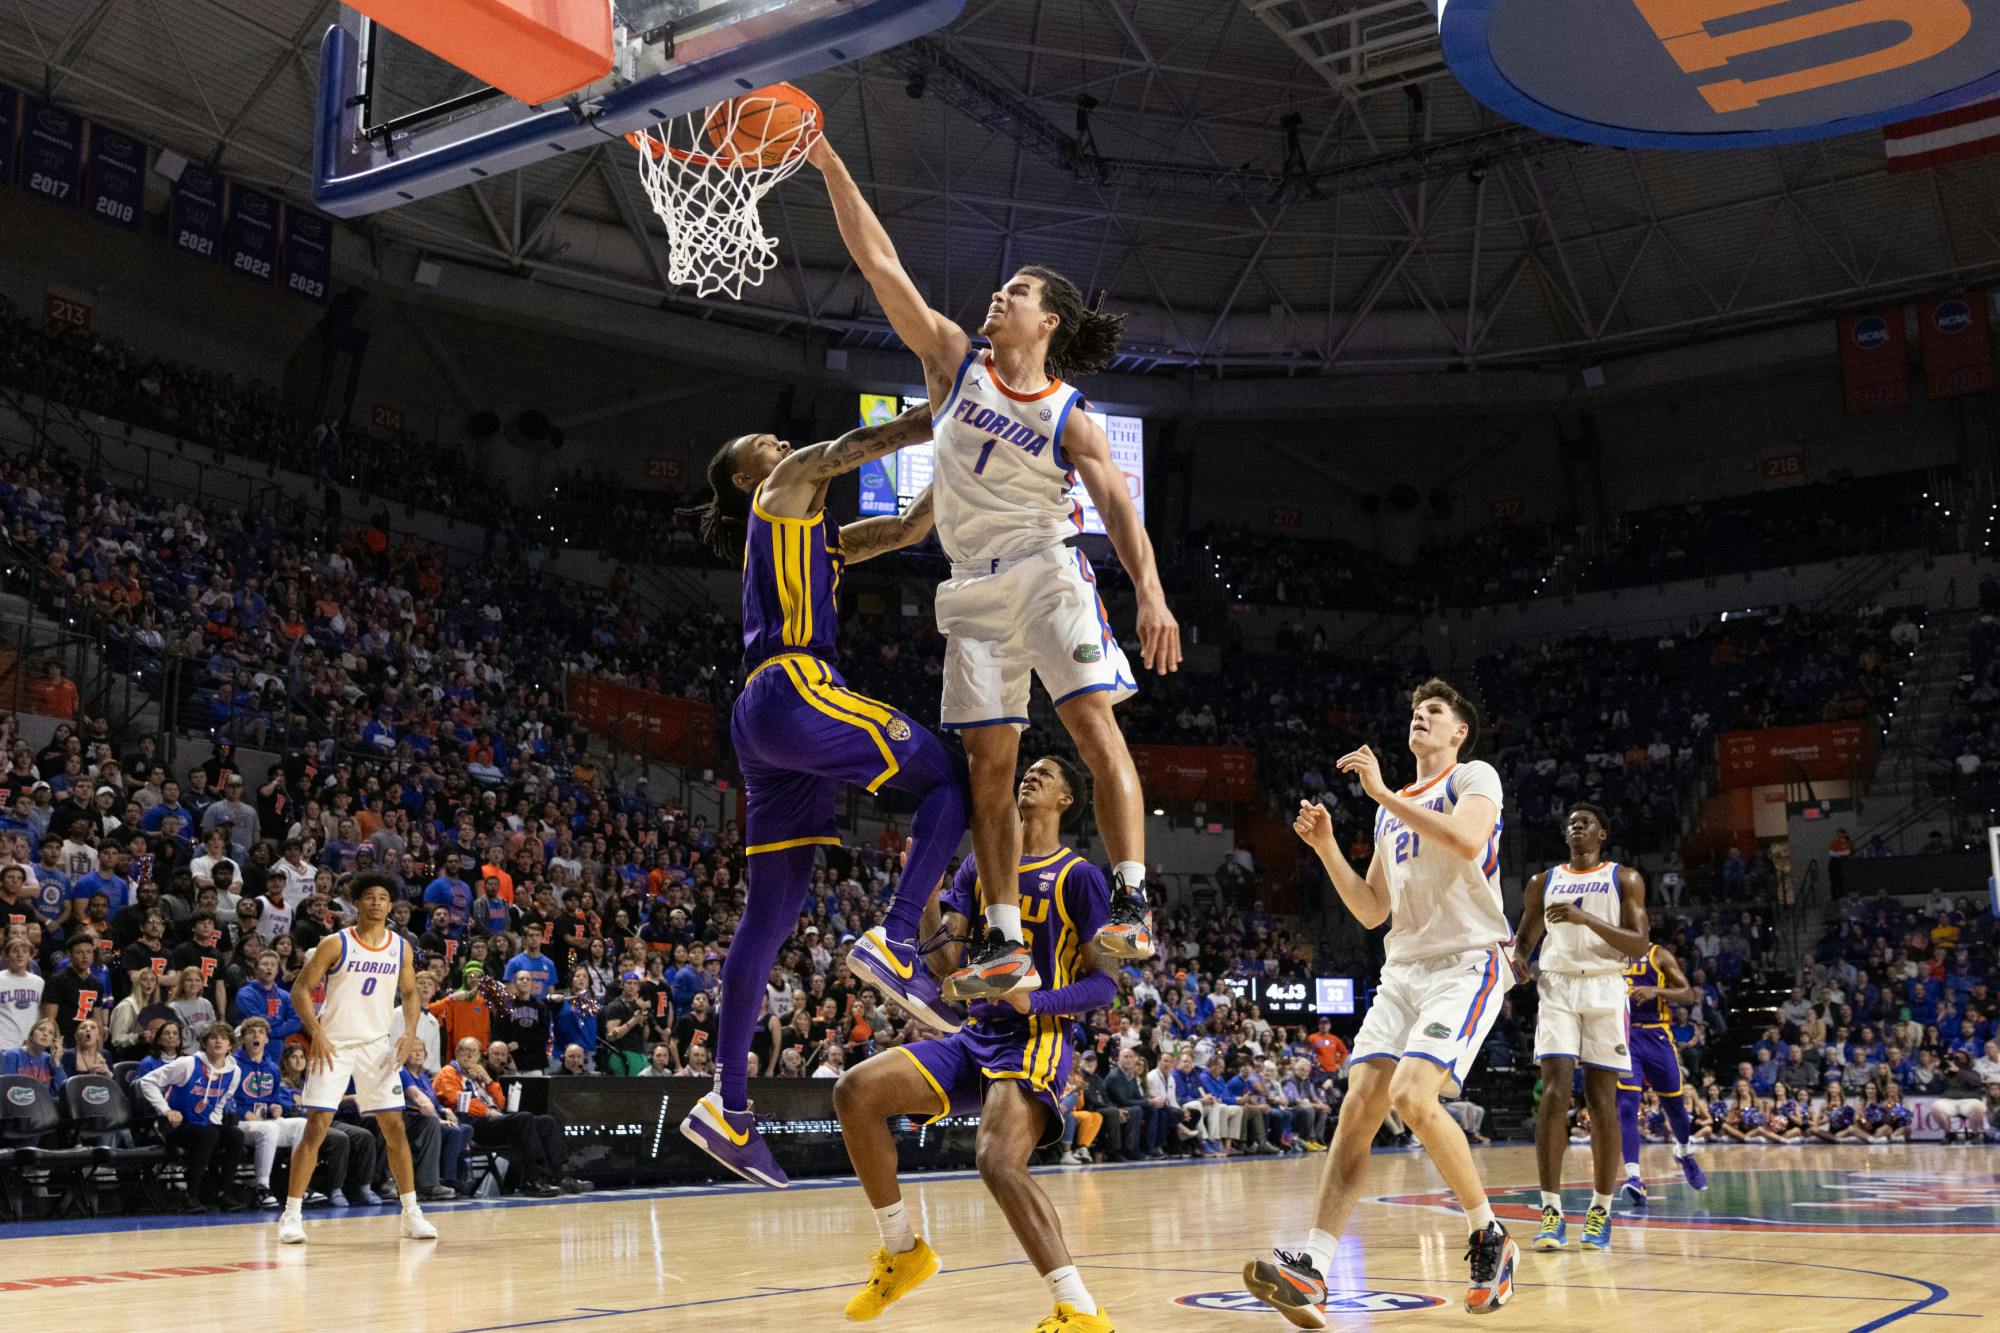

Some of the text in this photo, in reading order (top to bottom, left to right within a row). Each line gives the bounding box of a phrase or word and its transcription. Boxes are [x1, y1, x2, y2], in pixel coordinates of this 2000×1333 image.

[30, 173, 70, 198] 2017
[96, 197, 134, 222] 2018
[178, 230, 214, 256] 2021
[234, 252, 271, 278] 2022
[288, 273, 324, 298] 2023
[52, 300, 85, 325] 213
[1938, 314, 1971, 328] NCAA
[1856, 330, 1890, 343] NCAA
[376, 407, 400, 429] 214
[952, 398, 1049, 458] FLORIDA
[1111, 431, 1139, 443] THE
[973, 438, 998, 475] 1
[1111, 451, 1138, 461] BLUE
[1767, 457, 1799, 476] 218
[648, 460, 679, 477] 215
[991, 559, 999, 574] F
[1395, 831, 1420, 864] 21
[1551, 882, 1610, 895] FLORIDA
[273, 924, 284, 934] 24
[444, 939, 459, 964] F
[201, 956, 217, 987] F
[346, 960, 396, 975] FLORIDA
[361, 977, 377, 996] 0
[73, 990, 97, 1021] F
[267, 998, 281, 1017] F
[657, 992, 668, 1017] F
